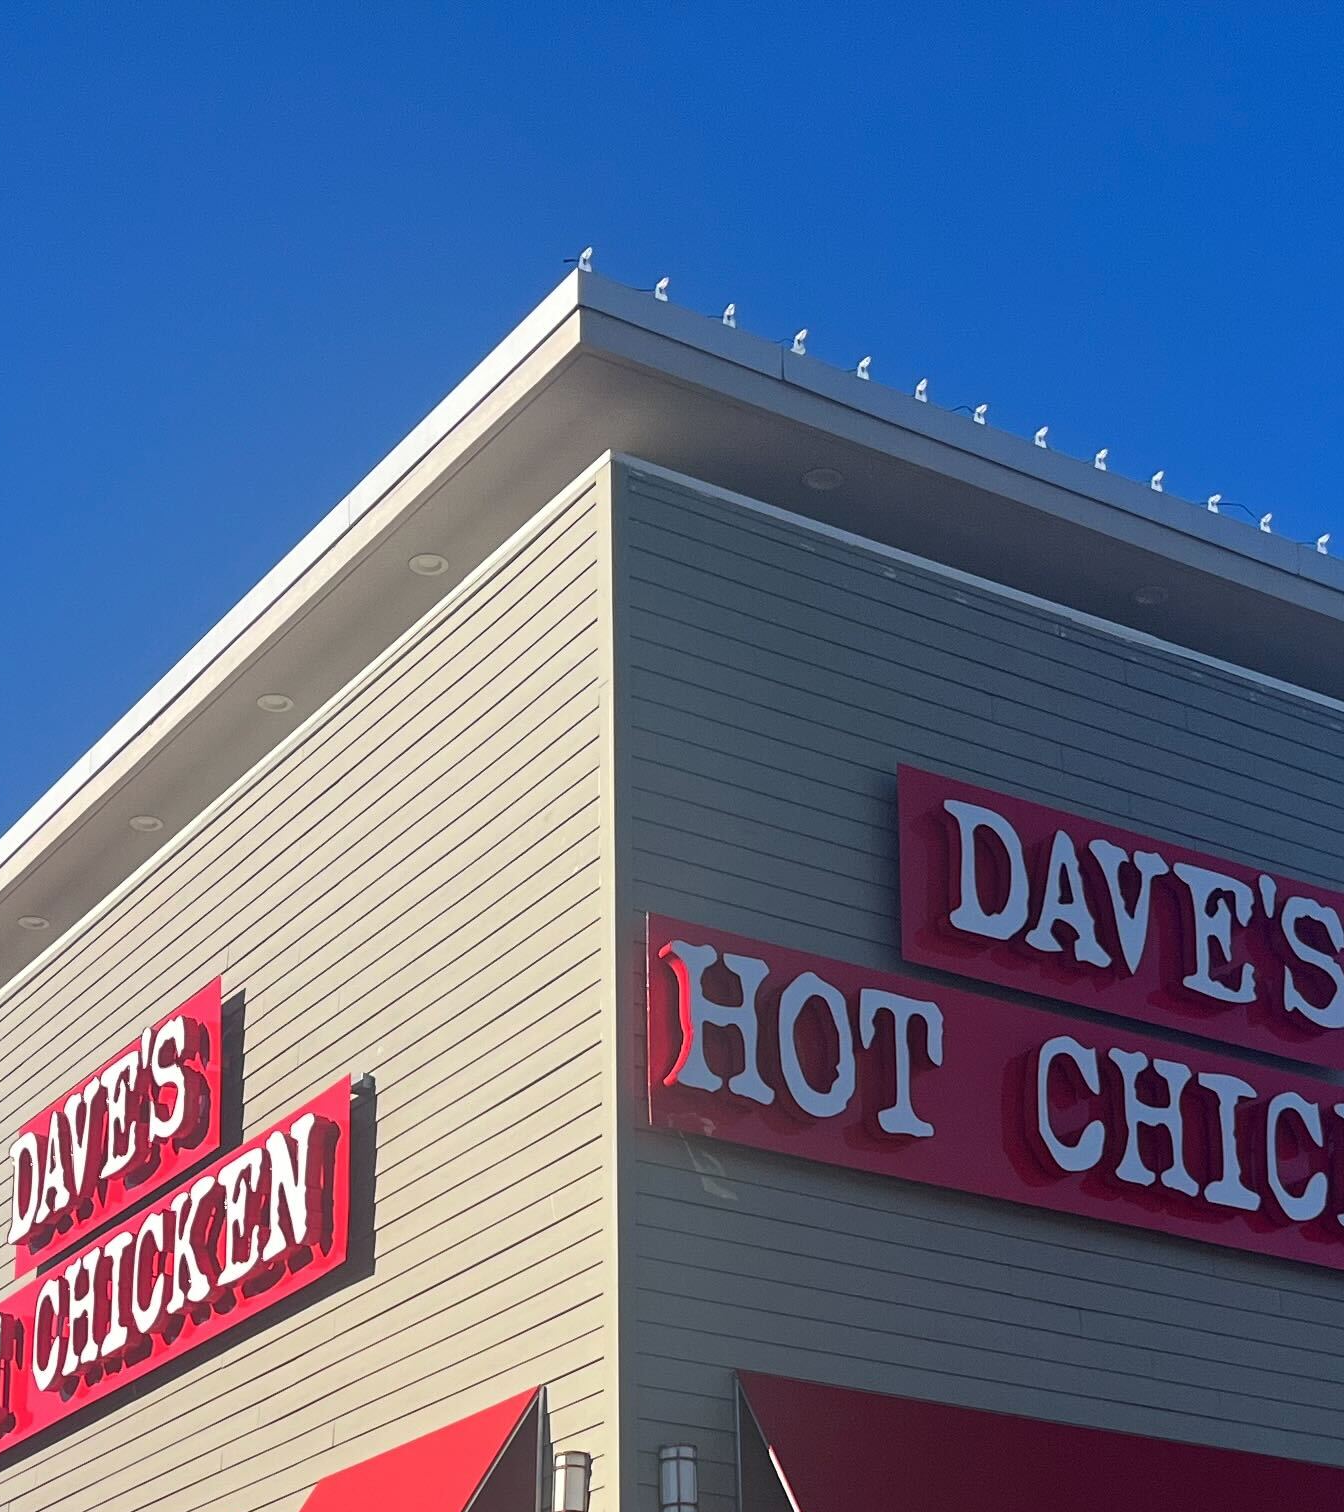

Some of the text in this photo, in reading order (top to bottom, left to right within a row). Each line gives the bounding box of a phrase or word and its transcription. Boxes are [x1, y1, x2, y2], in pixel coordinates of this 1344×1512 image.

[8, 1014, 188, 1245] DAVE'S
[659, 940, 944, 1137] HOT
[32, 1113, 316, 1392] CHICKEN
